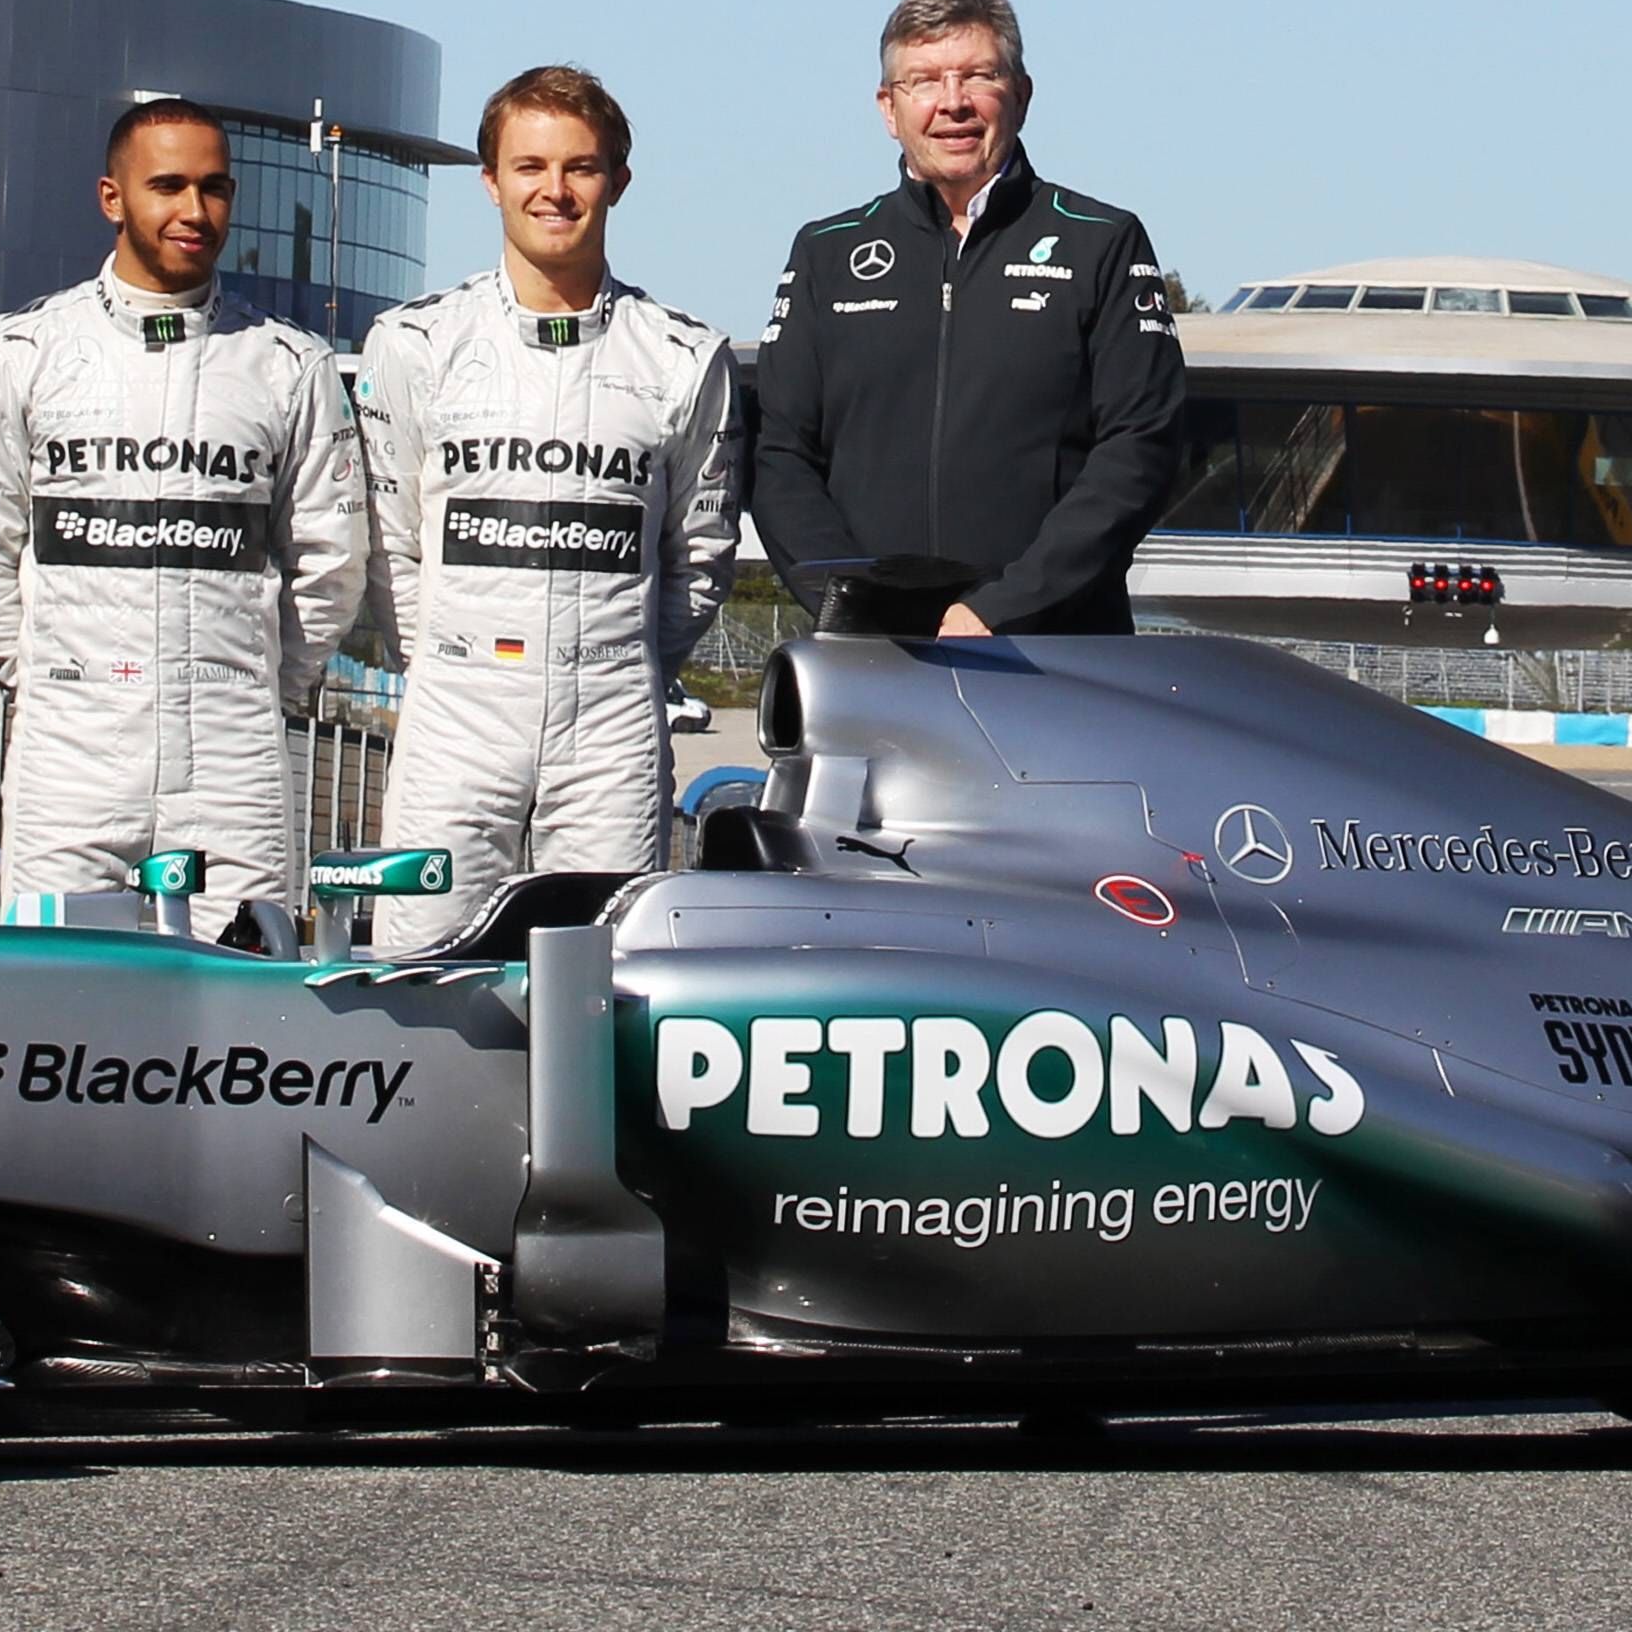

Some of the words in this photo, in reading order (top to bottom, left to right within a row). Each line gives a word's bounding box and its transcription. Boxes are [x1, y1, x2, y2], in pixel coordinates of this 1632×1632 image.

[1004, 263, 1073, 280] PETRONAS
[47, 437, 260, 484] PETRONAS
[442, 437, 652, 486] PETRONAS
[311, 867, 383, 886] ETRONAS
[17, 1042, 414, 1125] BlackBerry
[656, 1009, 1367, 1139] PETRONAS
[773, 1179, 1136, 1249] reimagining
[1152, 1177, 1324, 1233] energy
